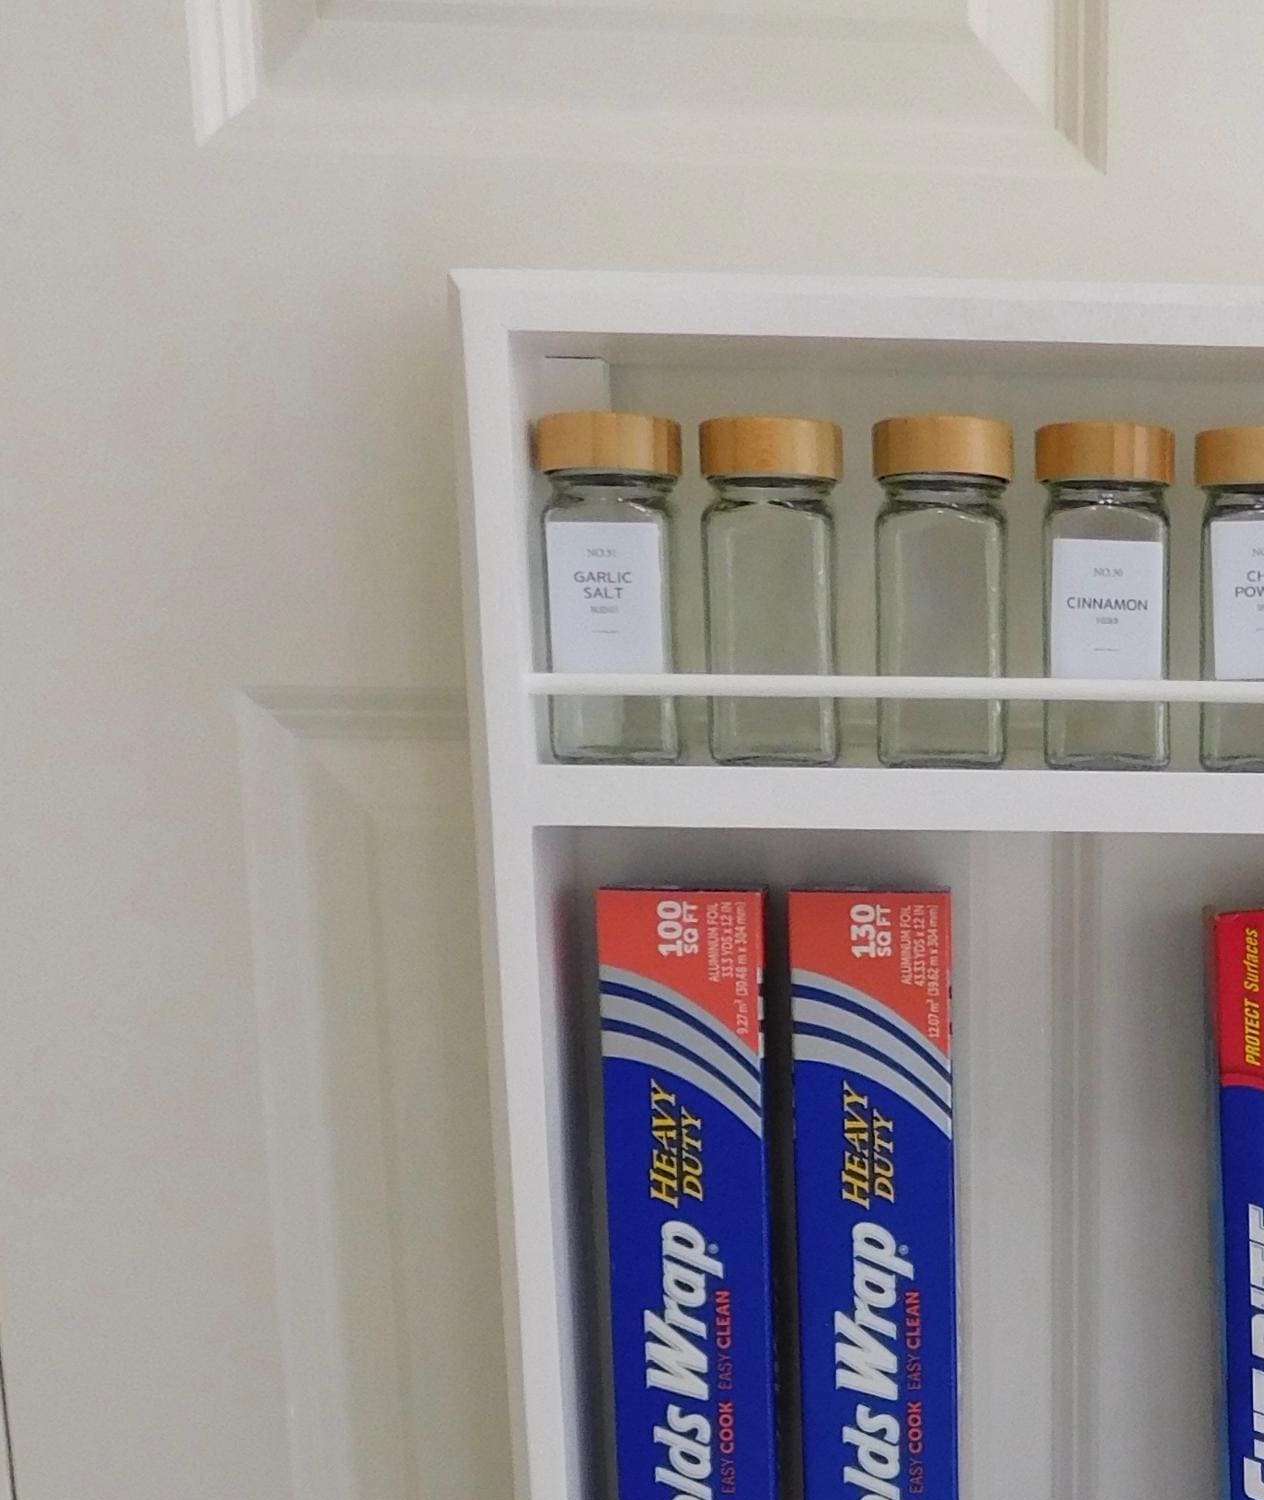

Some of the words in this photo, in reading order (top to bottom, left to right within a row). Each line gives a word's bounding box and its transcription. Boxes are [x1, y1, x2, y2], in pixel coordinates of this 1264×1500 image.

[574, 570, 632, 585] GARLIC
[583, 585, 624, 600] SALT
[1067, 596, 1149, 612] CINNAMON
[657, 900, 683, 957] 100
[683, 901, 698, 923] FT
[707, 902, 718, 925] FOIL
[721, 915, 732, 926] 12
[876, 904, 891, 926] FT
[900, 905, 911, 928] FOIL
[914, 904, 925, 916] IN
[914, 917, 925, 929] 12
[684, 928, 698, 954] SQ
[721, 936, 733, 956] YDS
[850, 903, 876, 959] 130
[876, 931, 891, 957] SQ
[914, 938, 925, 959] YDS
[708, 927, 720, 982] ALUMINUM
[901, 930, 912, 985] ALUMINUM
[1243, 927, 1259, 994] Surfaces
[1245, 998, 1261, 1067] PROTECT
[650, 1078, 679, 1209] HEAVY
[681, 1106, 703, 1201] DUTY
[841, 1080, 870, 1210] HEAVY
[873, 1108, 895, 1203] DUTY
[644, 1220, 724, 1401] Wrap
[715, 1290, 731, 1350] CLEAN
[834, 1221, 914, 1401] Wrap
[905, 1291, 920, 1350] CLEAN
[718, 1353, 733, 1390] EASY
[906, 1353, 922, 1390] EASY
[718, 1402, 735, 1454] COOK
[907, 1402, 922, 1454] COOK
[721, 1456, 736, 1494] EASY
[909, 1456, 923, 1494] EASY
